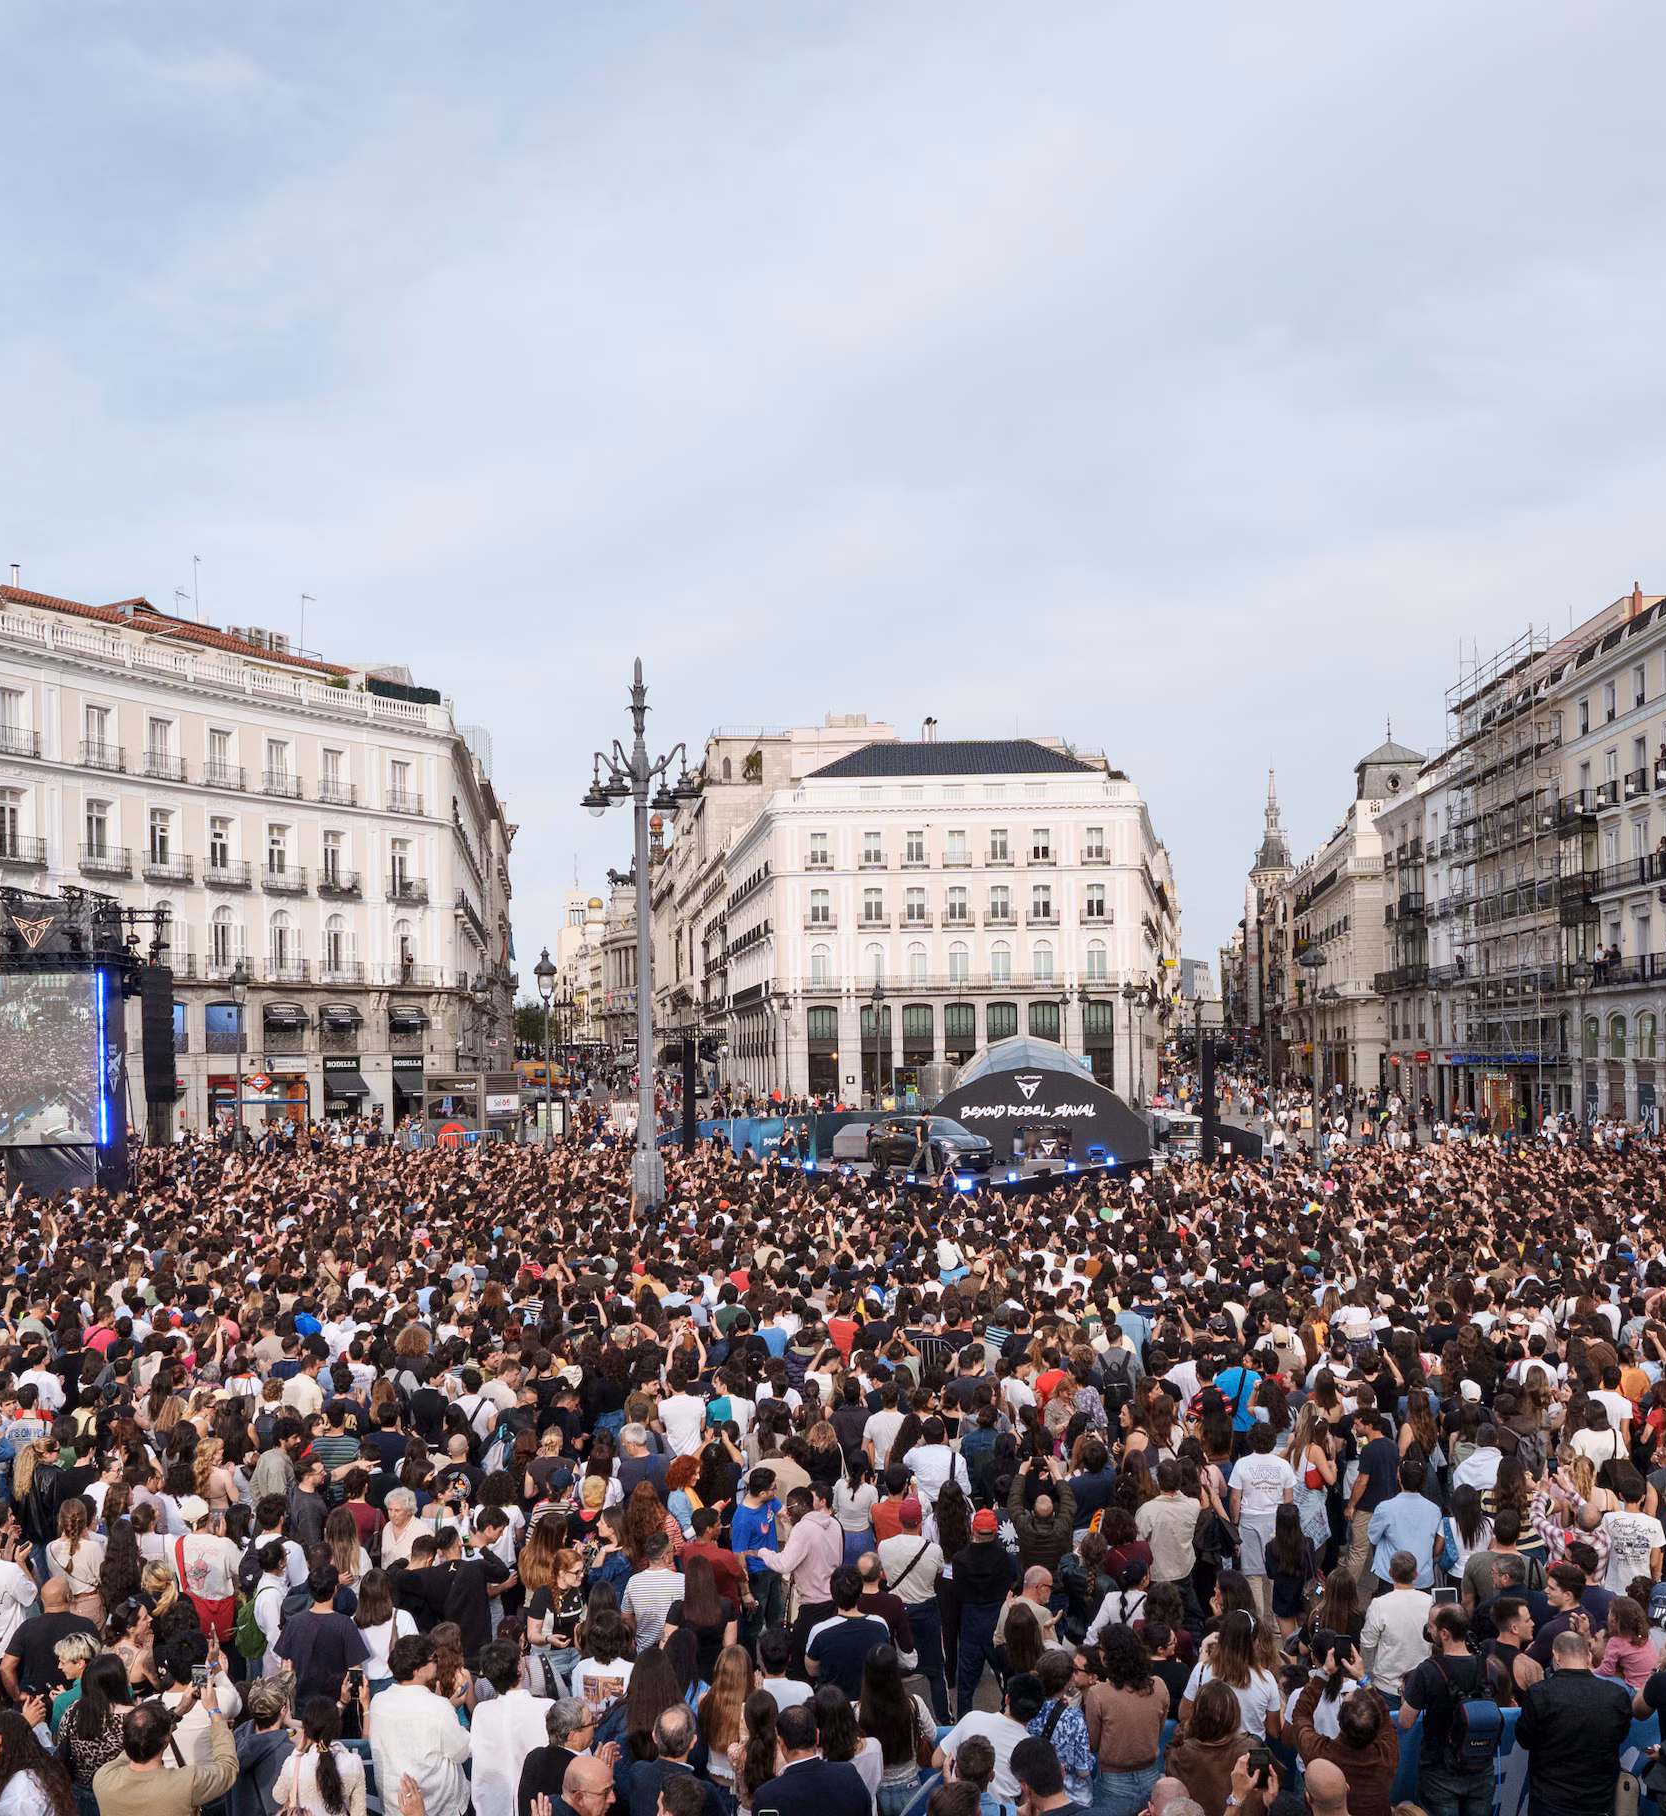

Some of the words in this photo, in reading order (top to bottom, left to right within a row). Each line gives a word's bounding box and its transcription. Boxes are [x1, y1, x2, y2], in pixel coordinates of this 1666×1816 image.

[326, 1060, 357, 1068] RODILLA
[494, 1098, 502, 1107] Sol
[961, 1105, 1006, 1119] BEYOND
[1007, 1103, 1051, 1118] REBEL.
[1249, 1466, 1282, 1480] VANS
